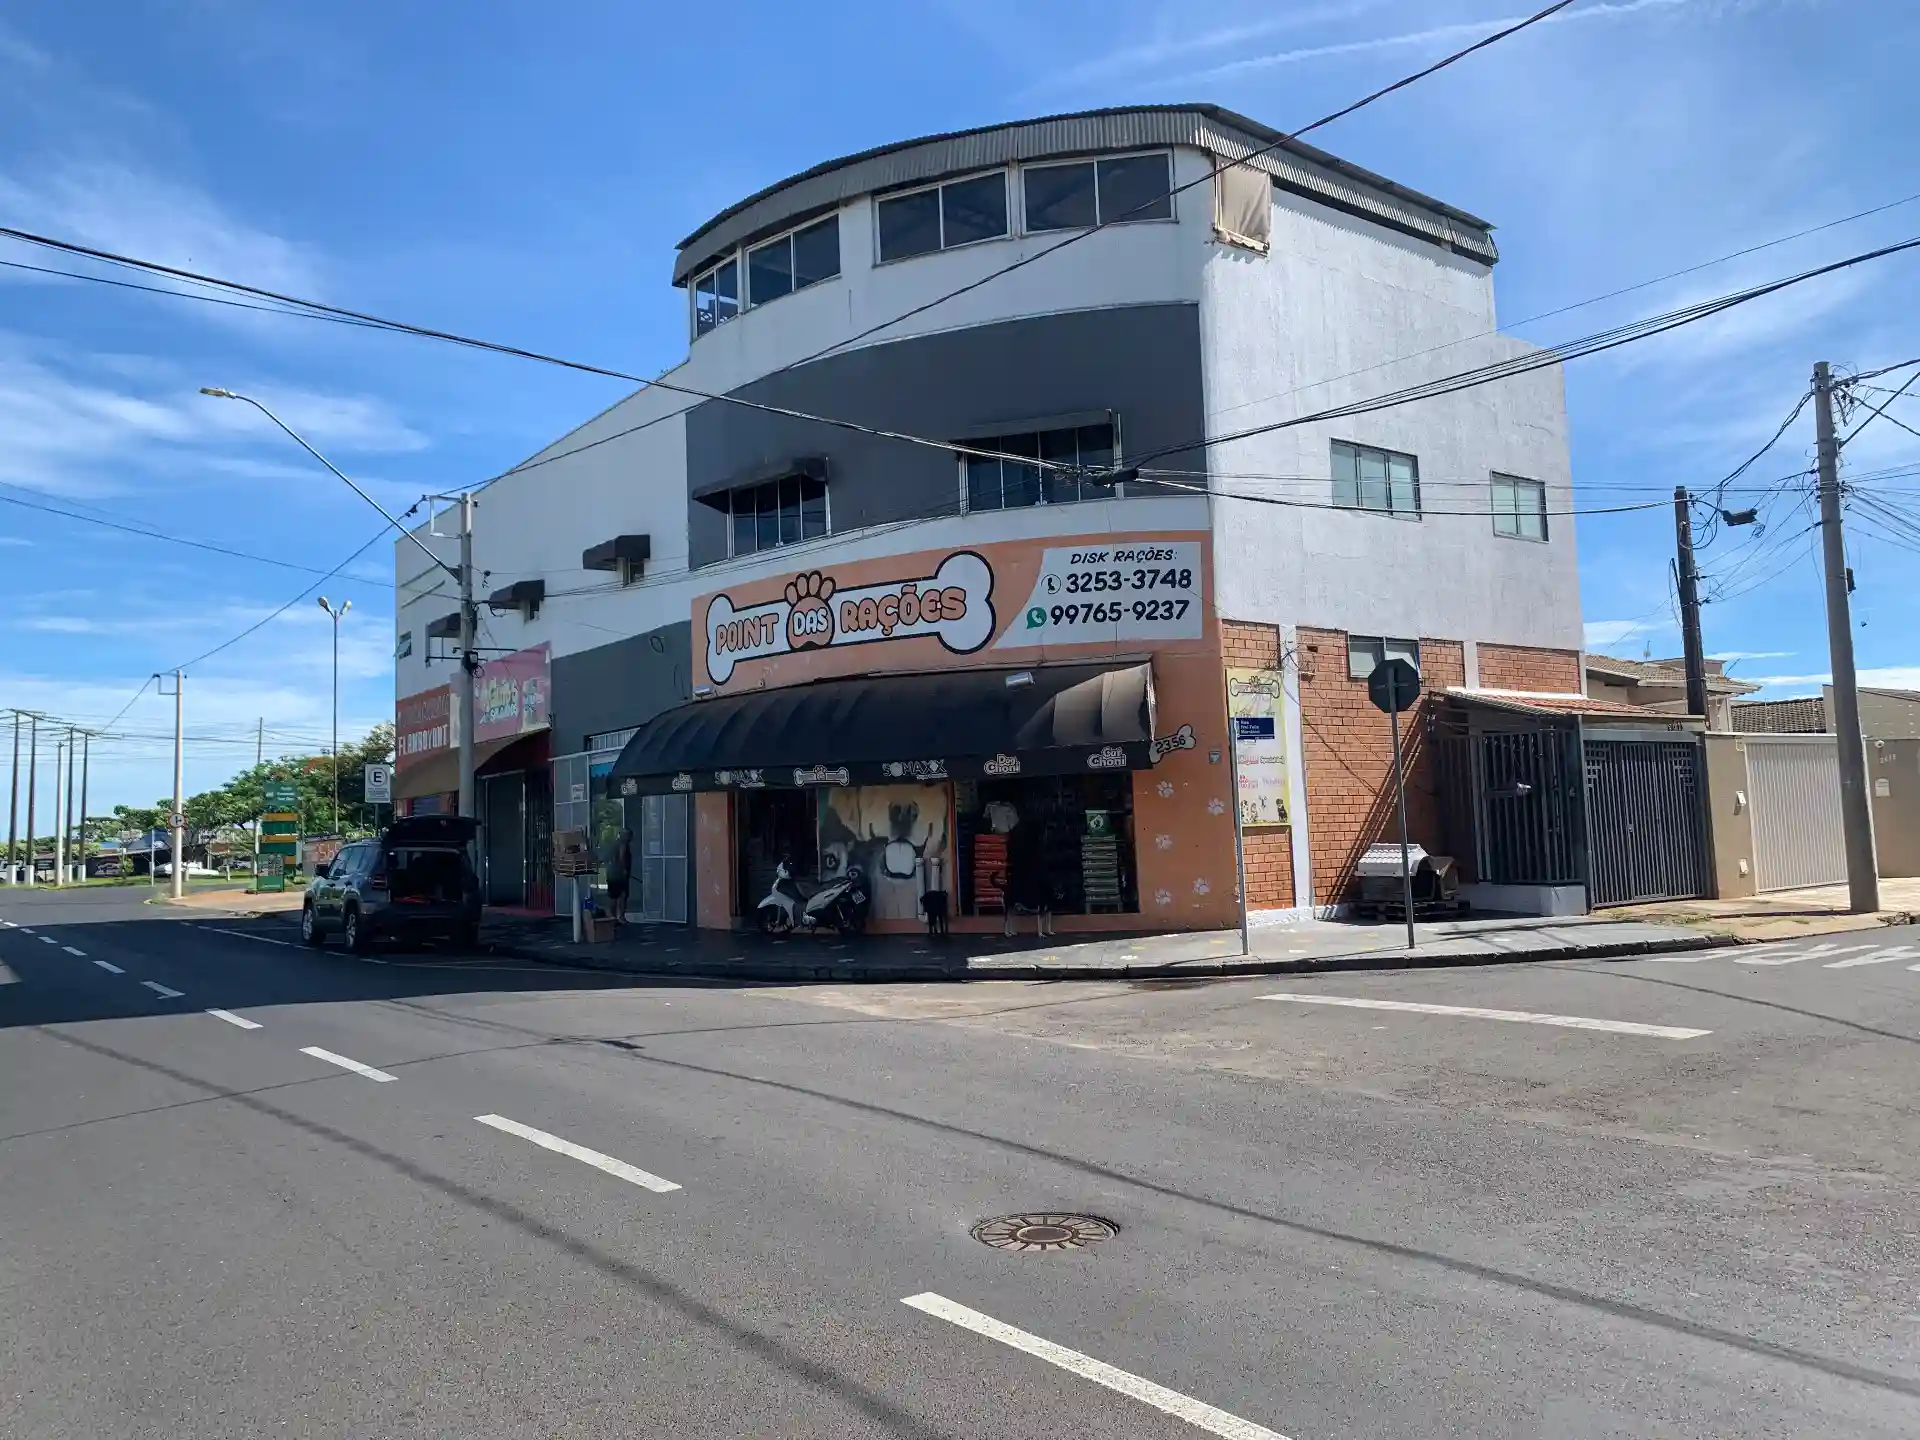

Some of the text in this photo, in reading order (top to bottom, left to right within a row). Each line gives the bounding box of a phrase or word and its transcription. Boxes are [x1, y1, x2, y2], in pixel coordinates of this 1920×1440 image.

[1070, 546, 1178, 565] DISK RAÇÕES:
[1066, 568, 1192, 594] 3253-3748
[715, 583, 967, 655] POINT DAS RAÇÕES
[1050, 599, 1190, 626] 99765-9237
[1101, 746, 1123, 758] Cat
[1154, 734, 1187, 753] 2356
[984, 760, 1021, 775] Choni
[996, 754, 1017, 766] Dog
[1087, 753, 1127, 769] Choni
[373, 771, 383, 783] E
